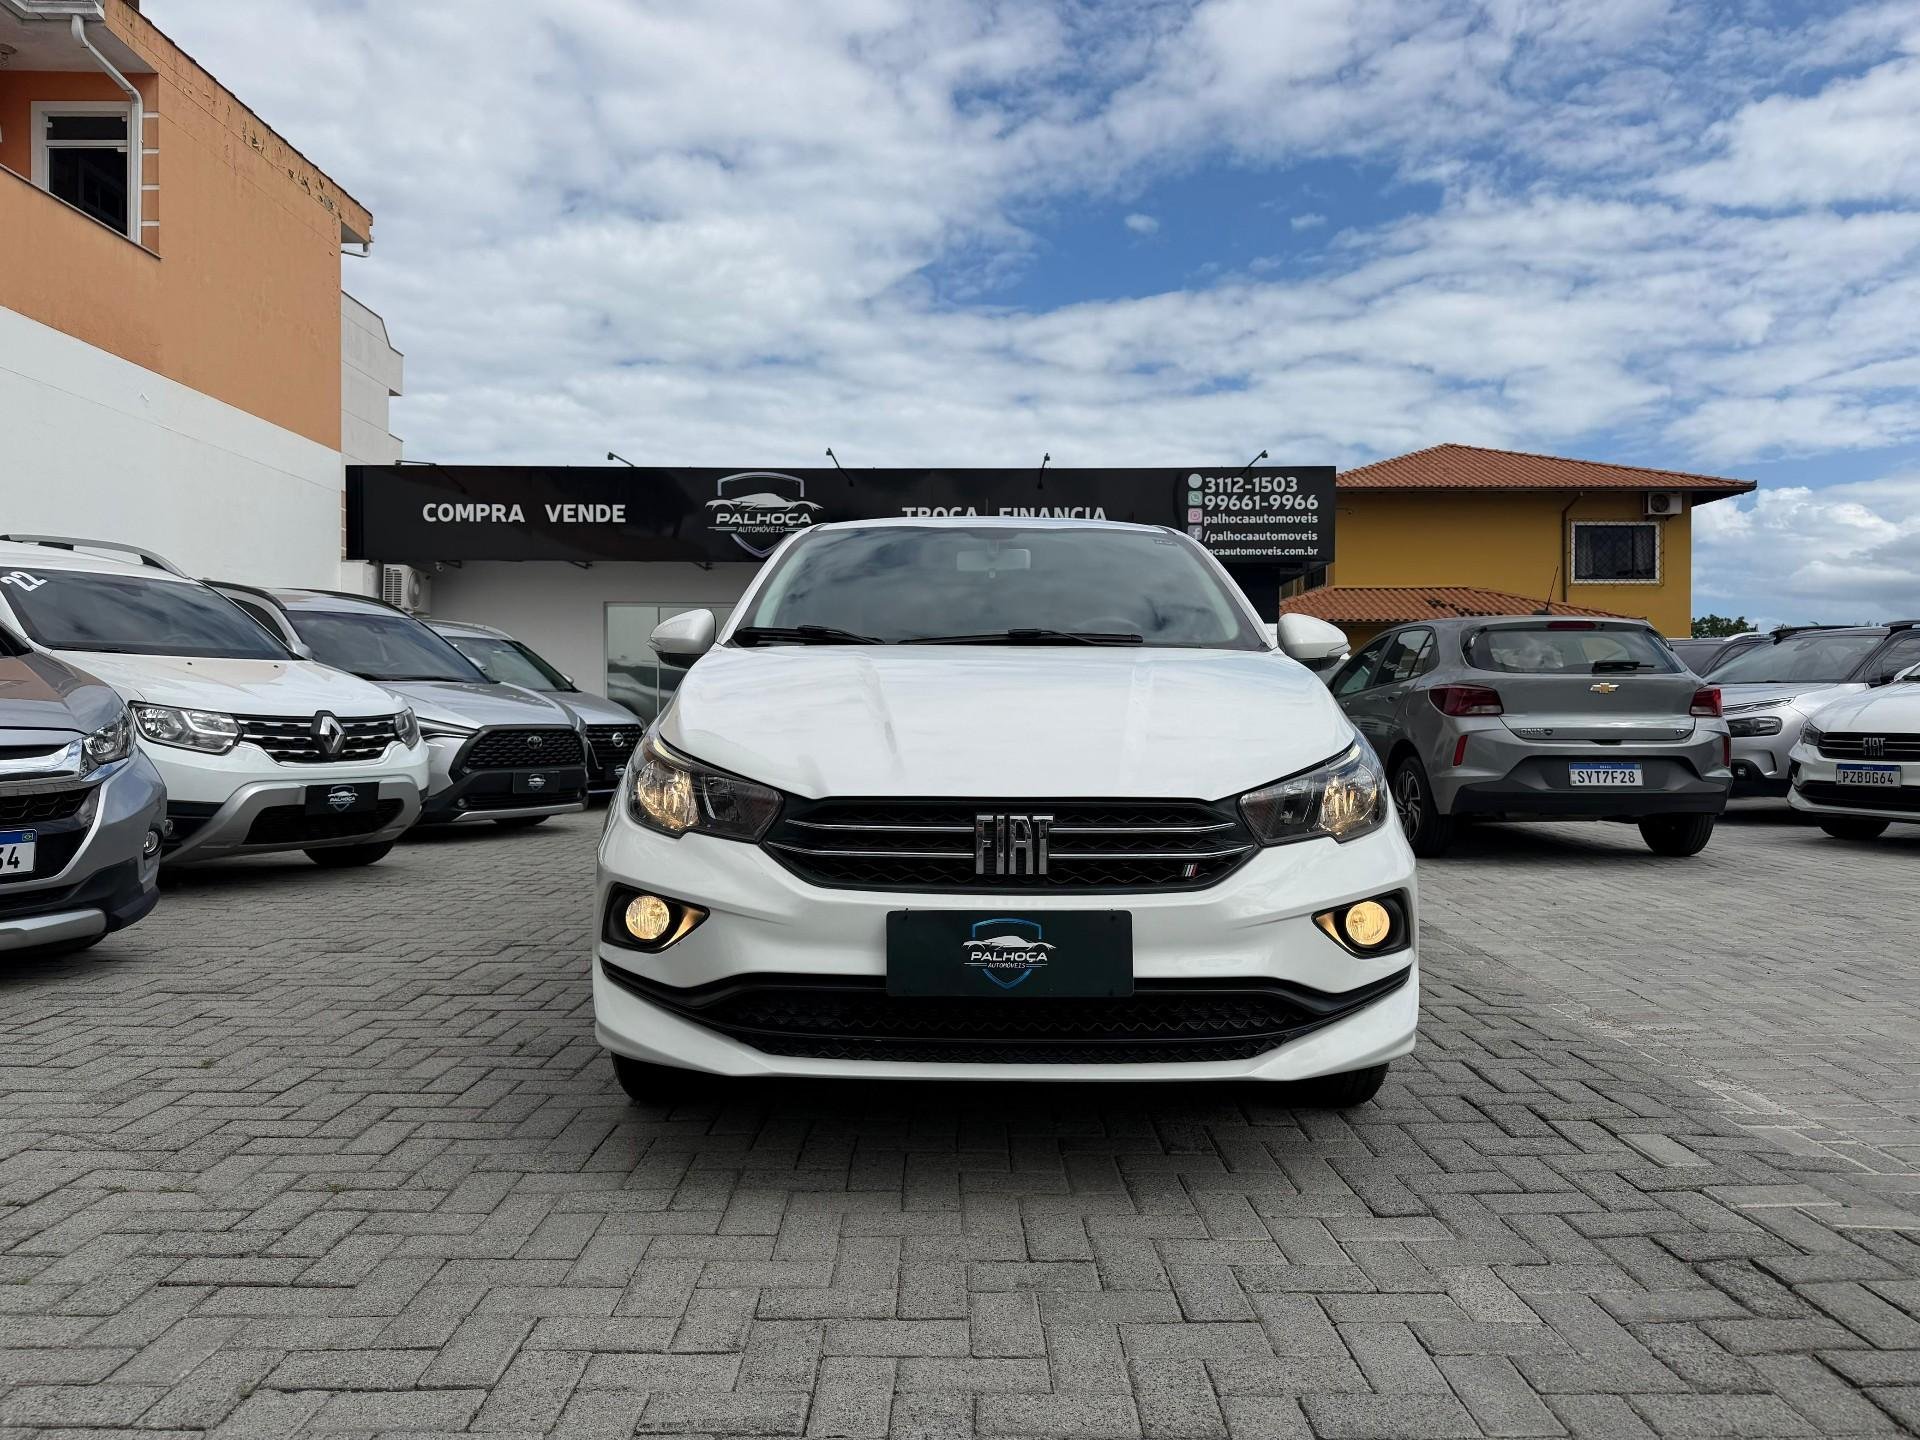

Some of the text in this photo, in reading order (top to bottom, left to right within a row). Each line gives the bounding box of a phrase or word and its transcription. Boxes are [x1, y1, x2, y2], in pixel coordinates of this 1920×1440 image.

[1204, 476, 1298, 493] 3112-1503
[1204, 494, 1319, 511] 99661-9966
[422, 503, 627, 523] COMPRA VENDE
[715, 512, 812, 526] PALHOÇA
[1203, 512, 1318, 527] palhocaautomoveis
[737, 525, 785, 533] AUTOMÓVEIS
[1203, 530, 1318, 544] /palhocaautomoveis
[1208, 546, 1319, 556] ocaautomoveis.com.br
[1577, 770, 1636, 784] SYT7F28
[975, 814, 1054, 875] FIAT
[970, 951, 1048, 963] PALHOÇA
